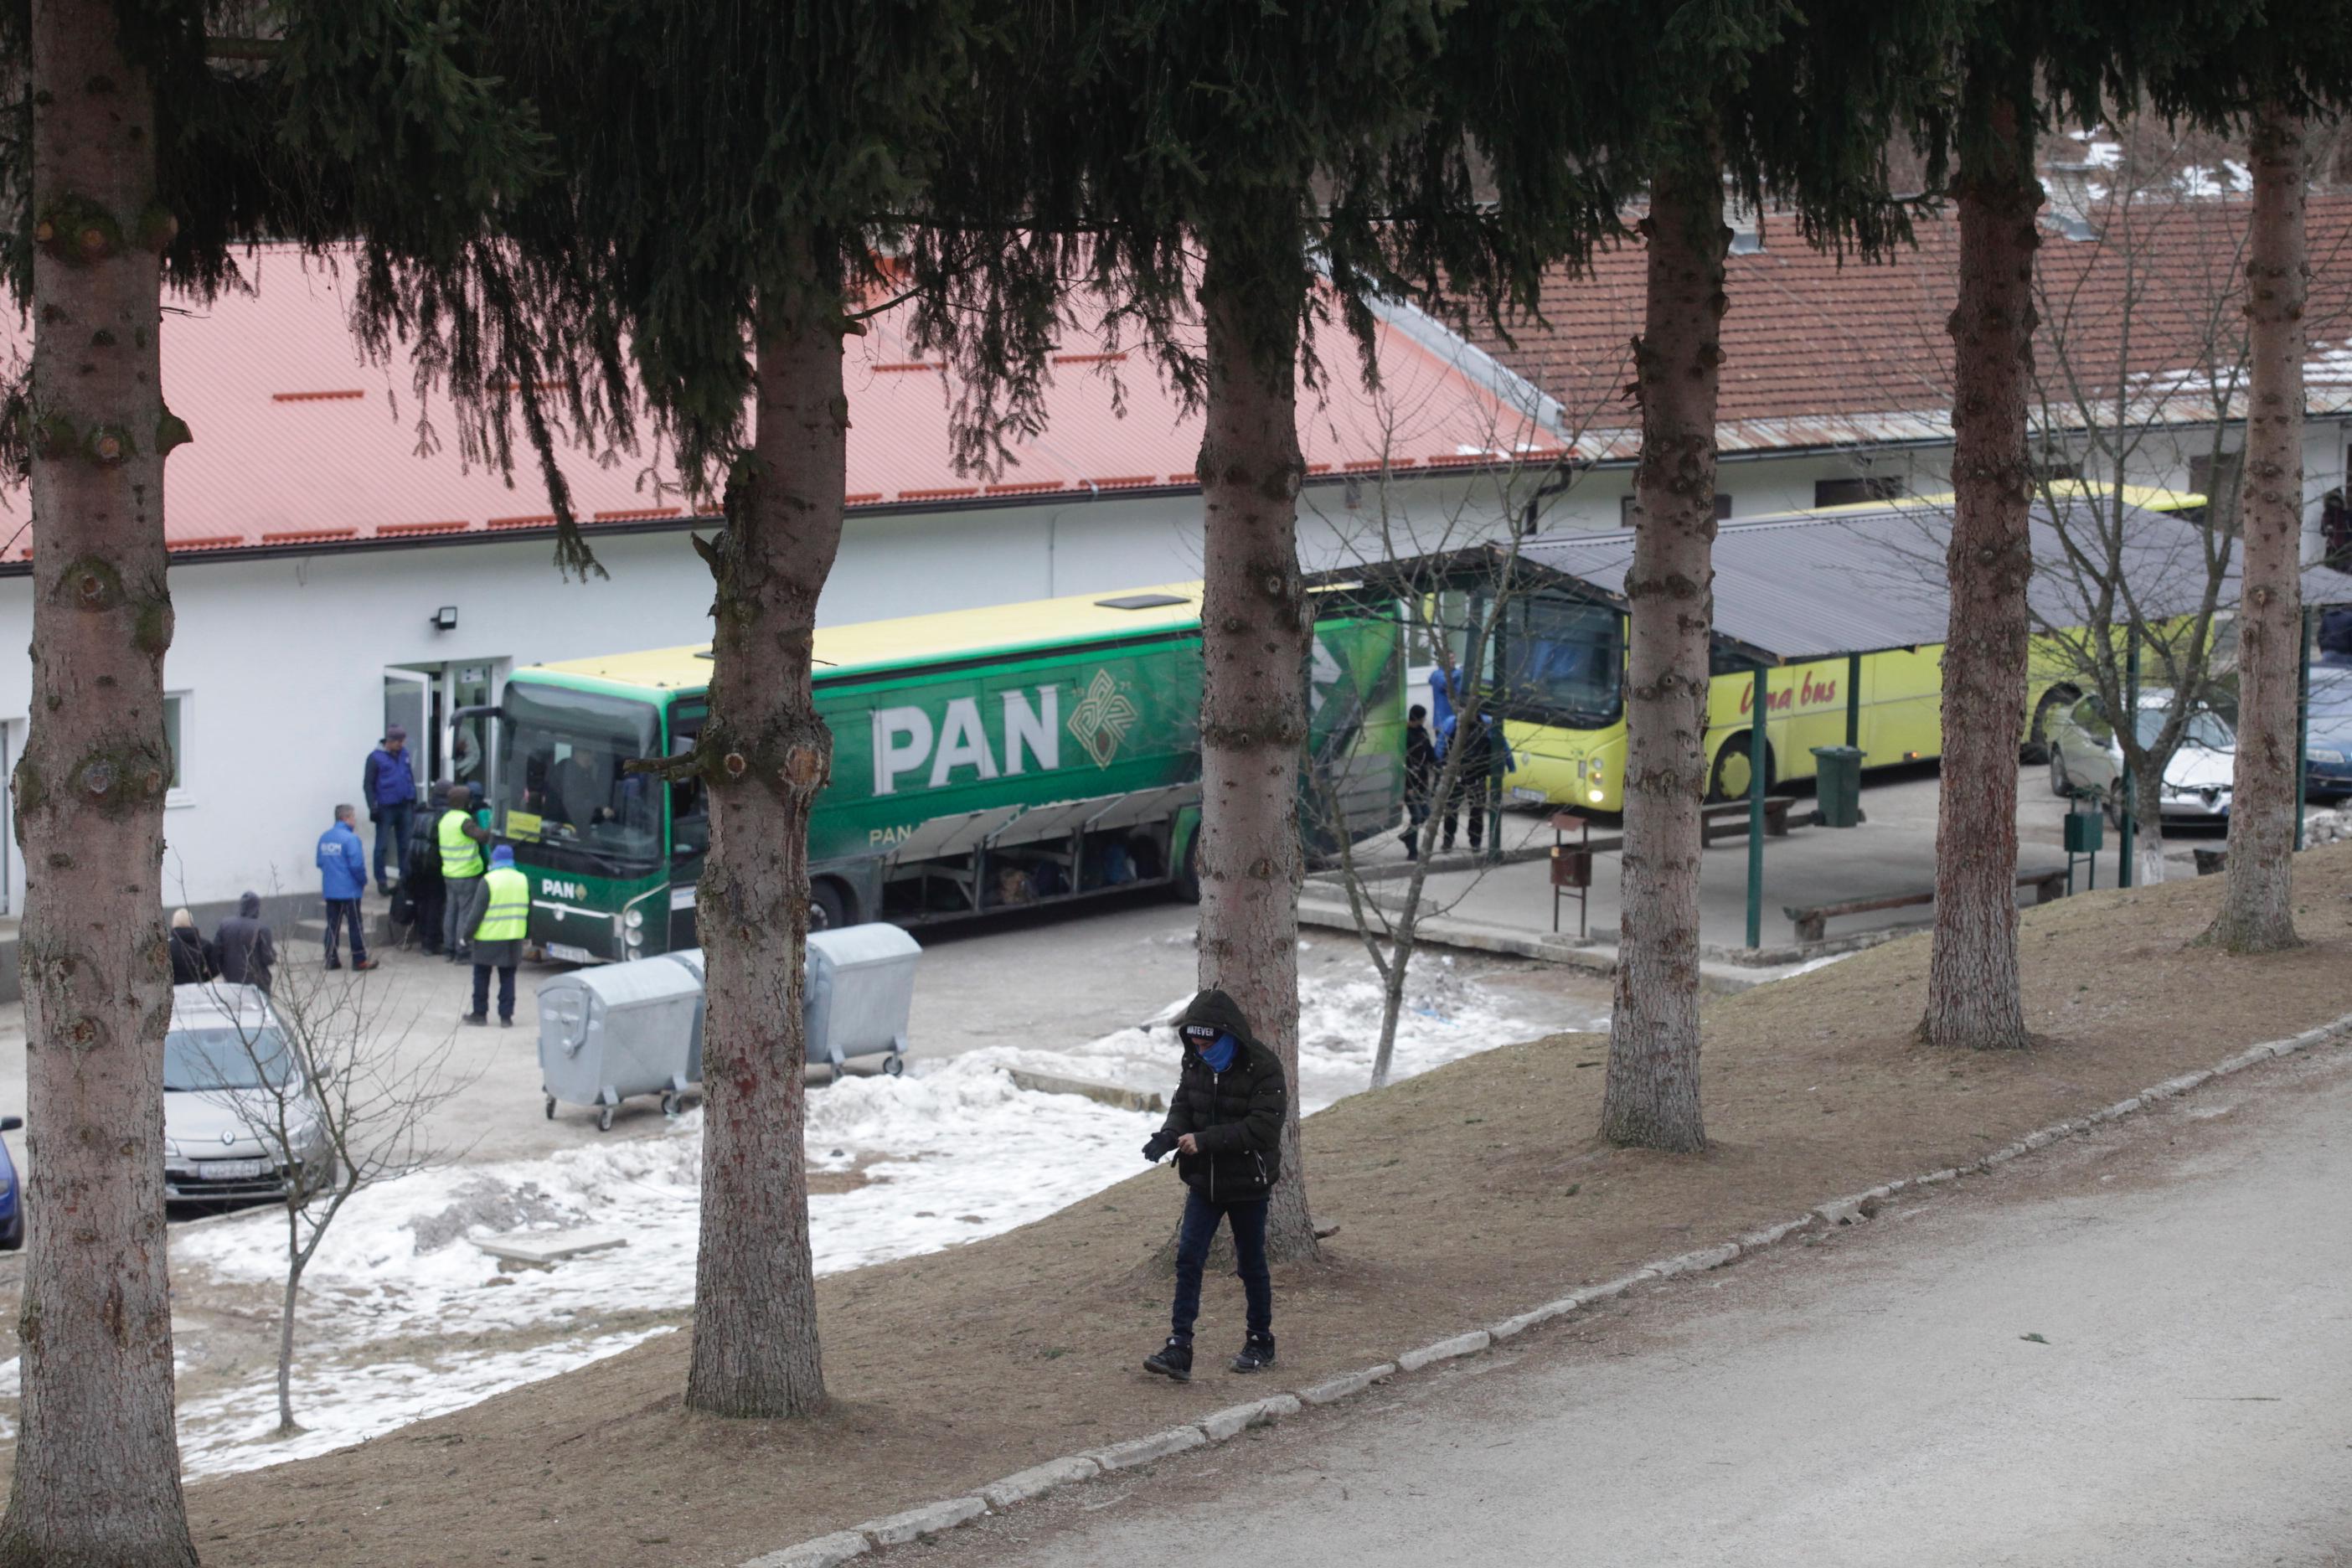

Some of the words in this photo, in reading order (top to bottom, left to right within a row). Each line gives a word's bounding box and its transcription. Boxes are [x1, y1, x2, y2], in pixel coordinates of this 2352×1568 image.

[1800, 670, 1836, 706] bus
[868, 683, 1060, 797] PAN
[869, 824, 912, 847] PAN
[542, 878, 575, 900] PAN
